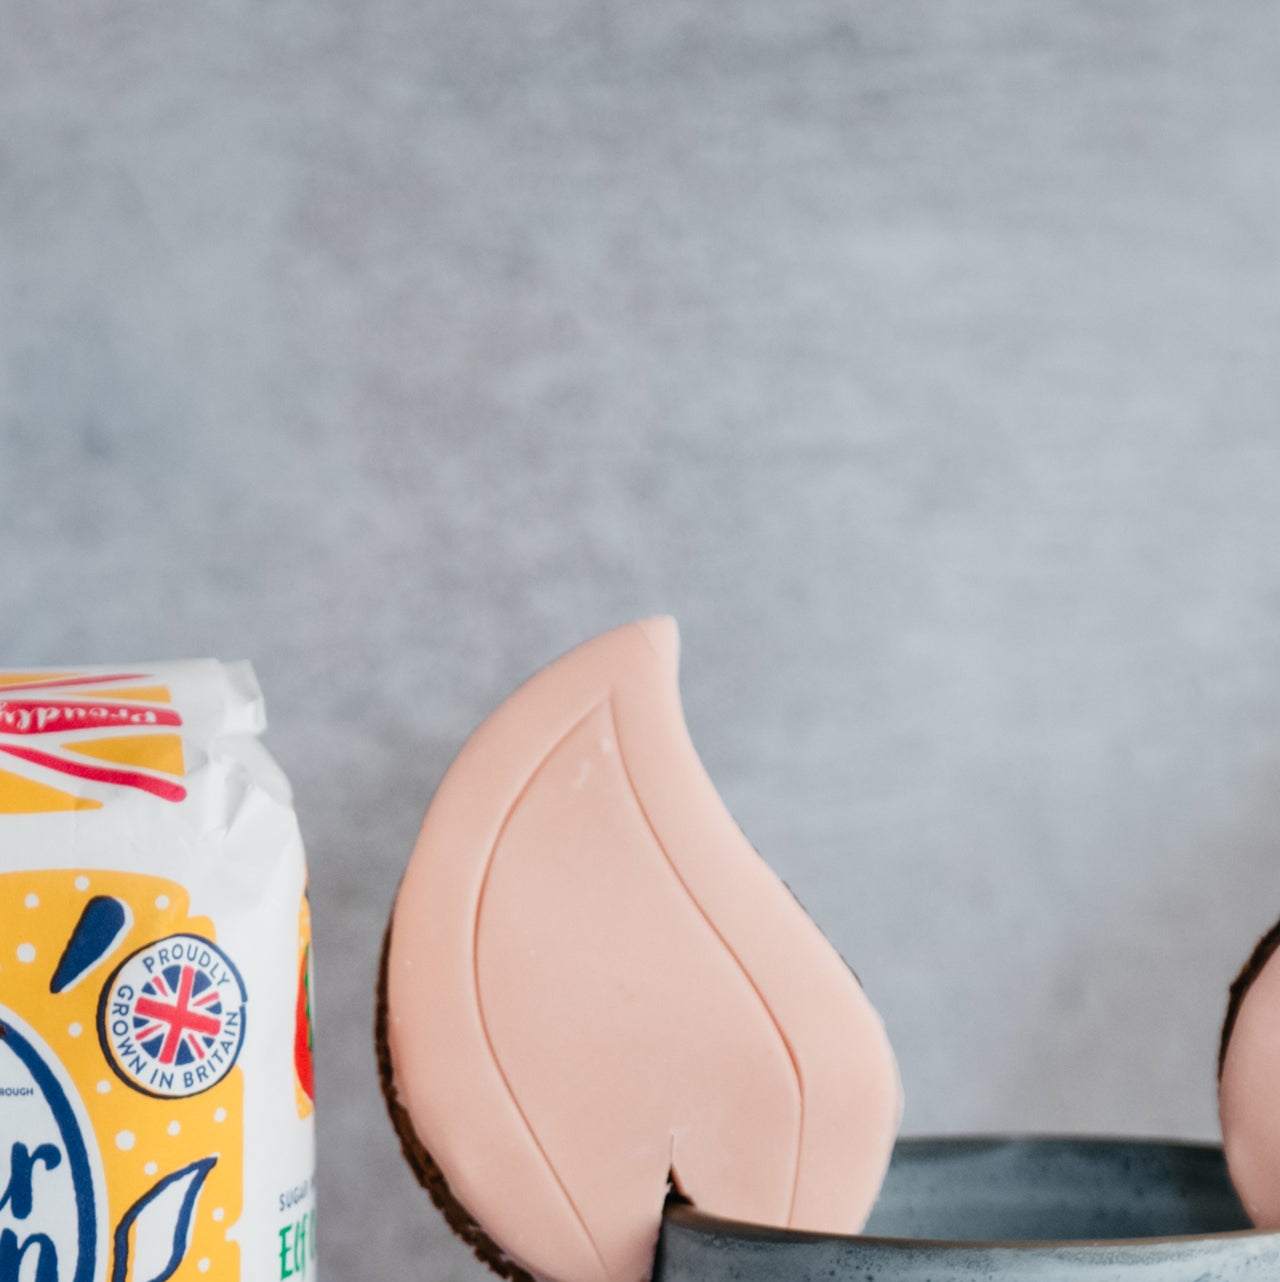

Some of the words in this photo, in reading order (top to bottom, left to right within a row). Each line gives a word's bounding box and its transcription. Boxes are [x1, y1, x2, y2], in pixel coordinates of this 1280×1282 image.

[142, 943, 231, 986] PROUDLY
[112, 984, 148, 1075] GROWN
[149, 1068, 175, 1089] IN
[183, 1011, 239, 1089] BRITAIN
